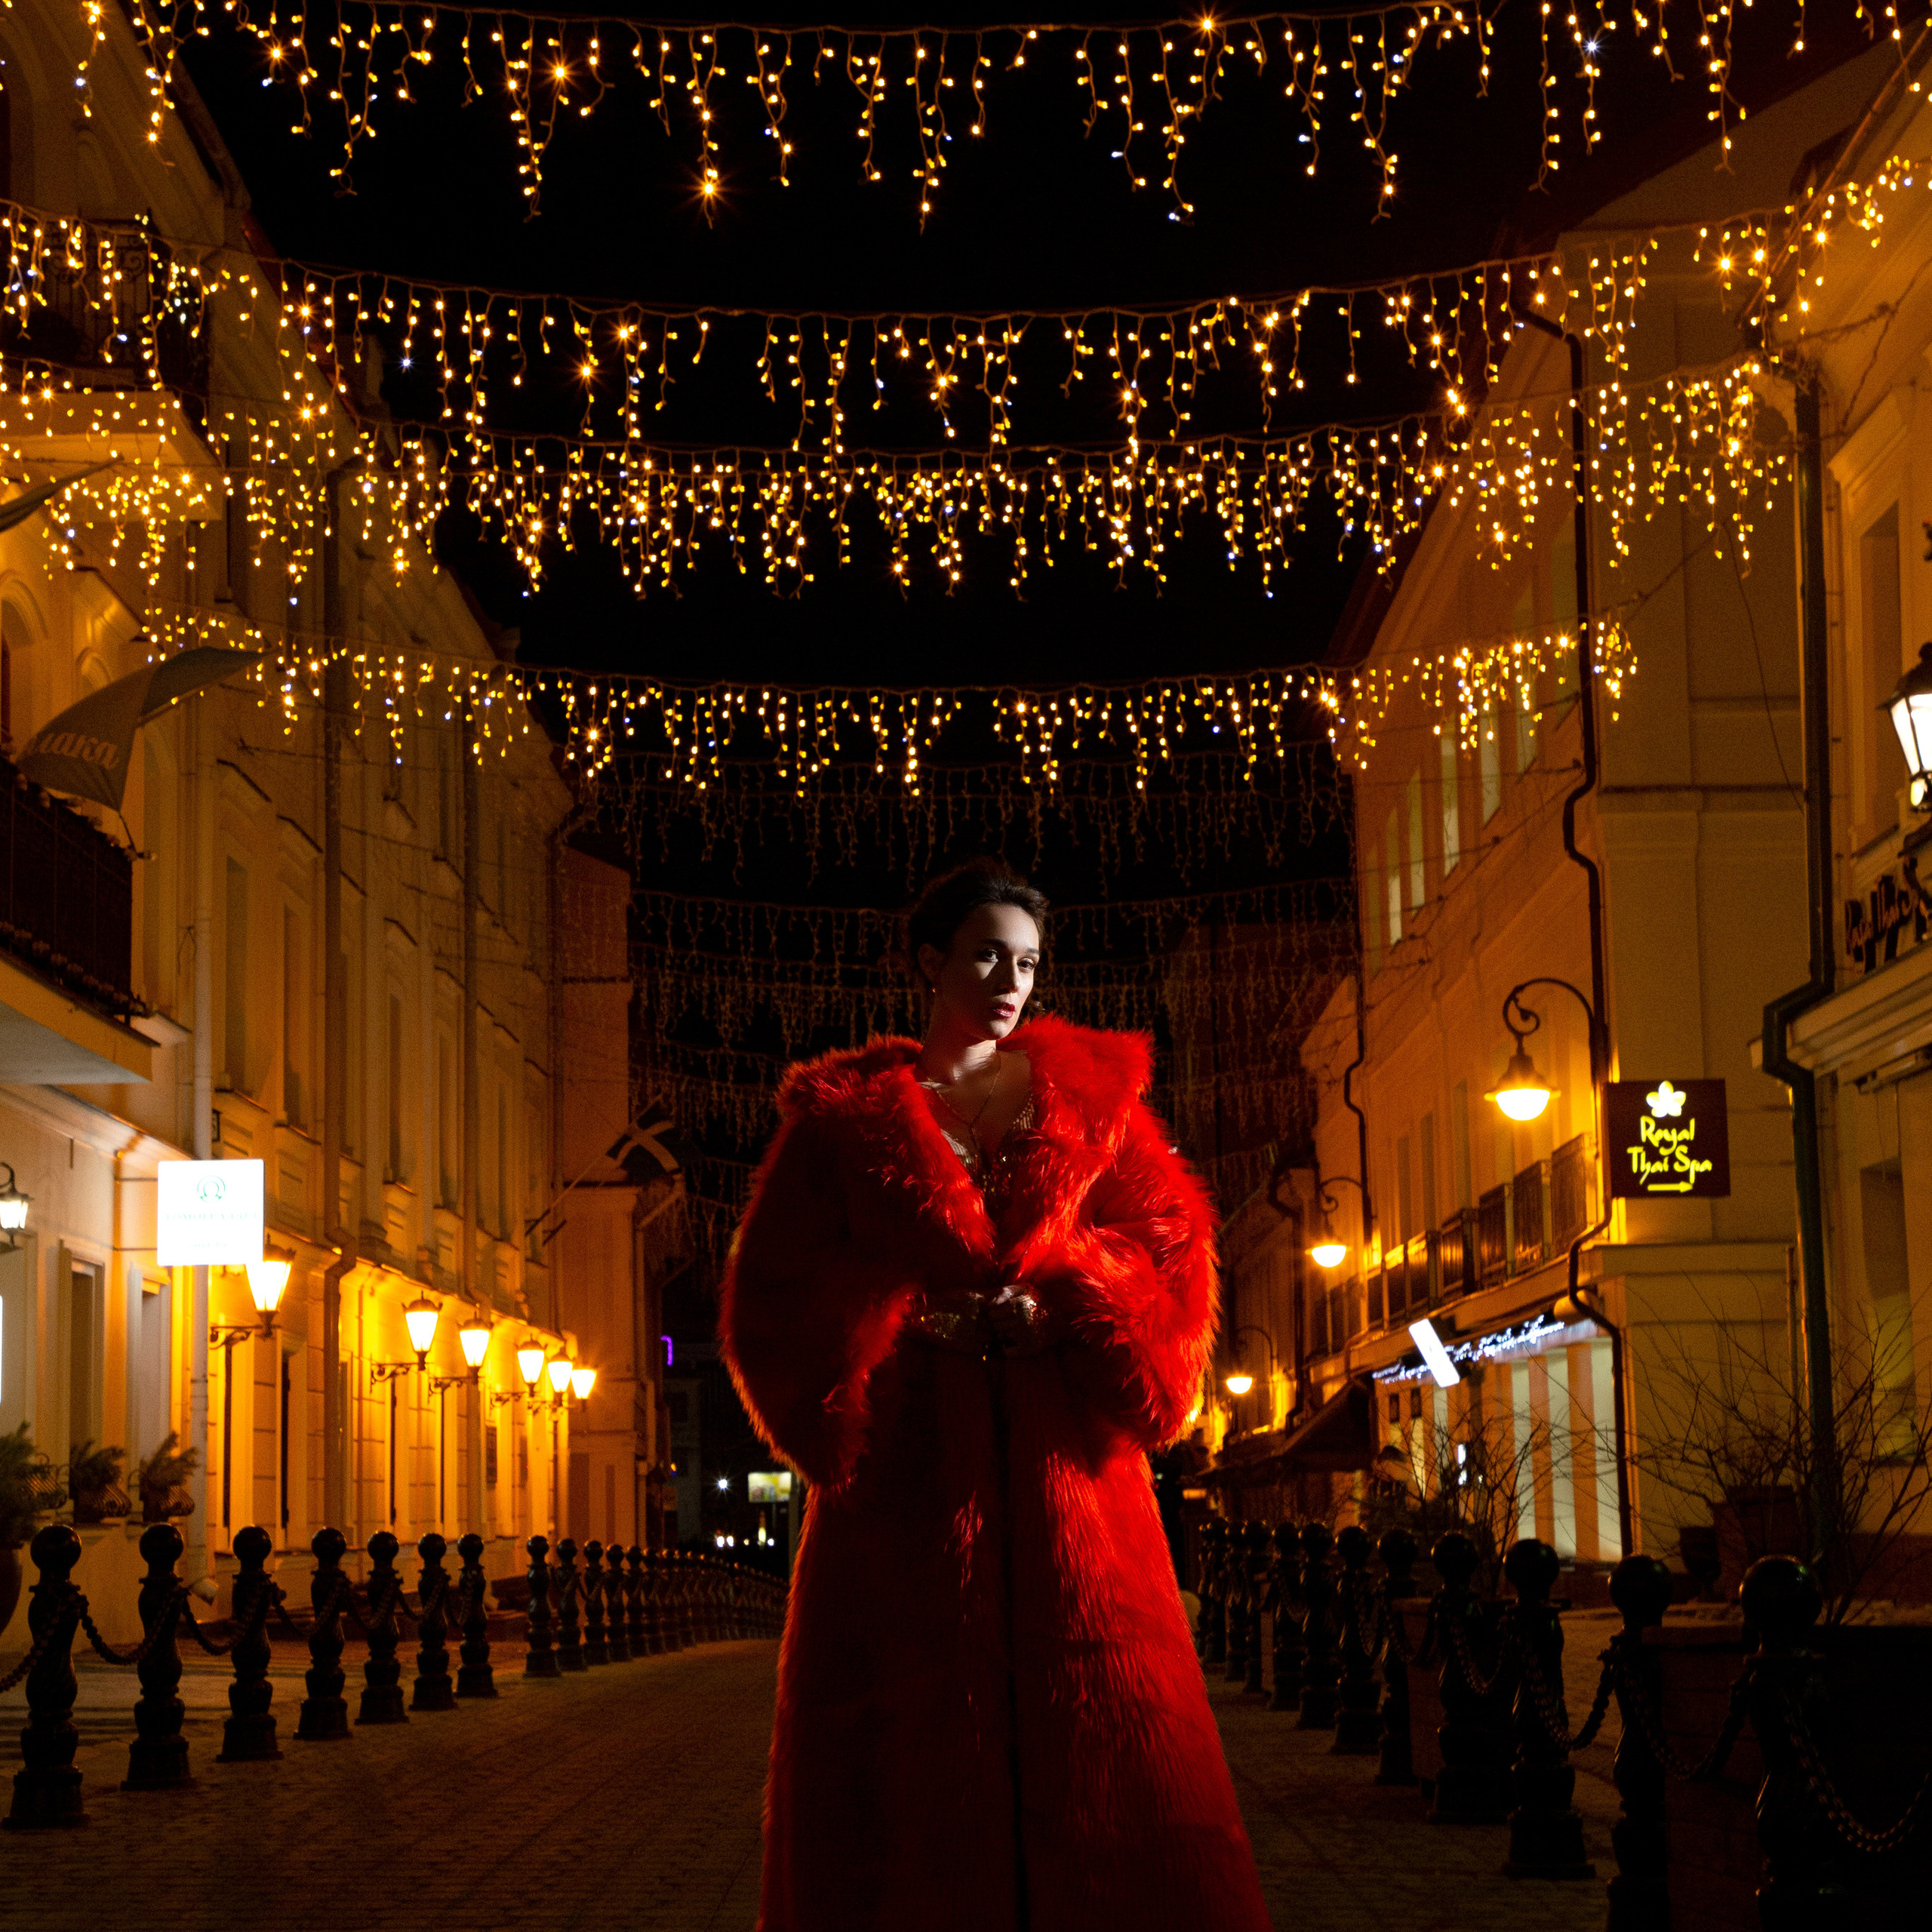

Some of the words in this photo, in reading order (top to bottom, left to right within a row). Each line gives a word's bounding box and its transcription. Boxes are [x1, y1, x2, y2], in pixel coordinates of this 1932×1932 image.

[1640, 1115, 1695, 1155] Royal
[1626, 1146, 1669, 1185] Thai
[1673, 1144, 1712, 1184] Spa
